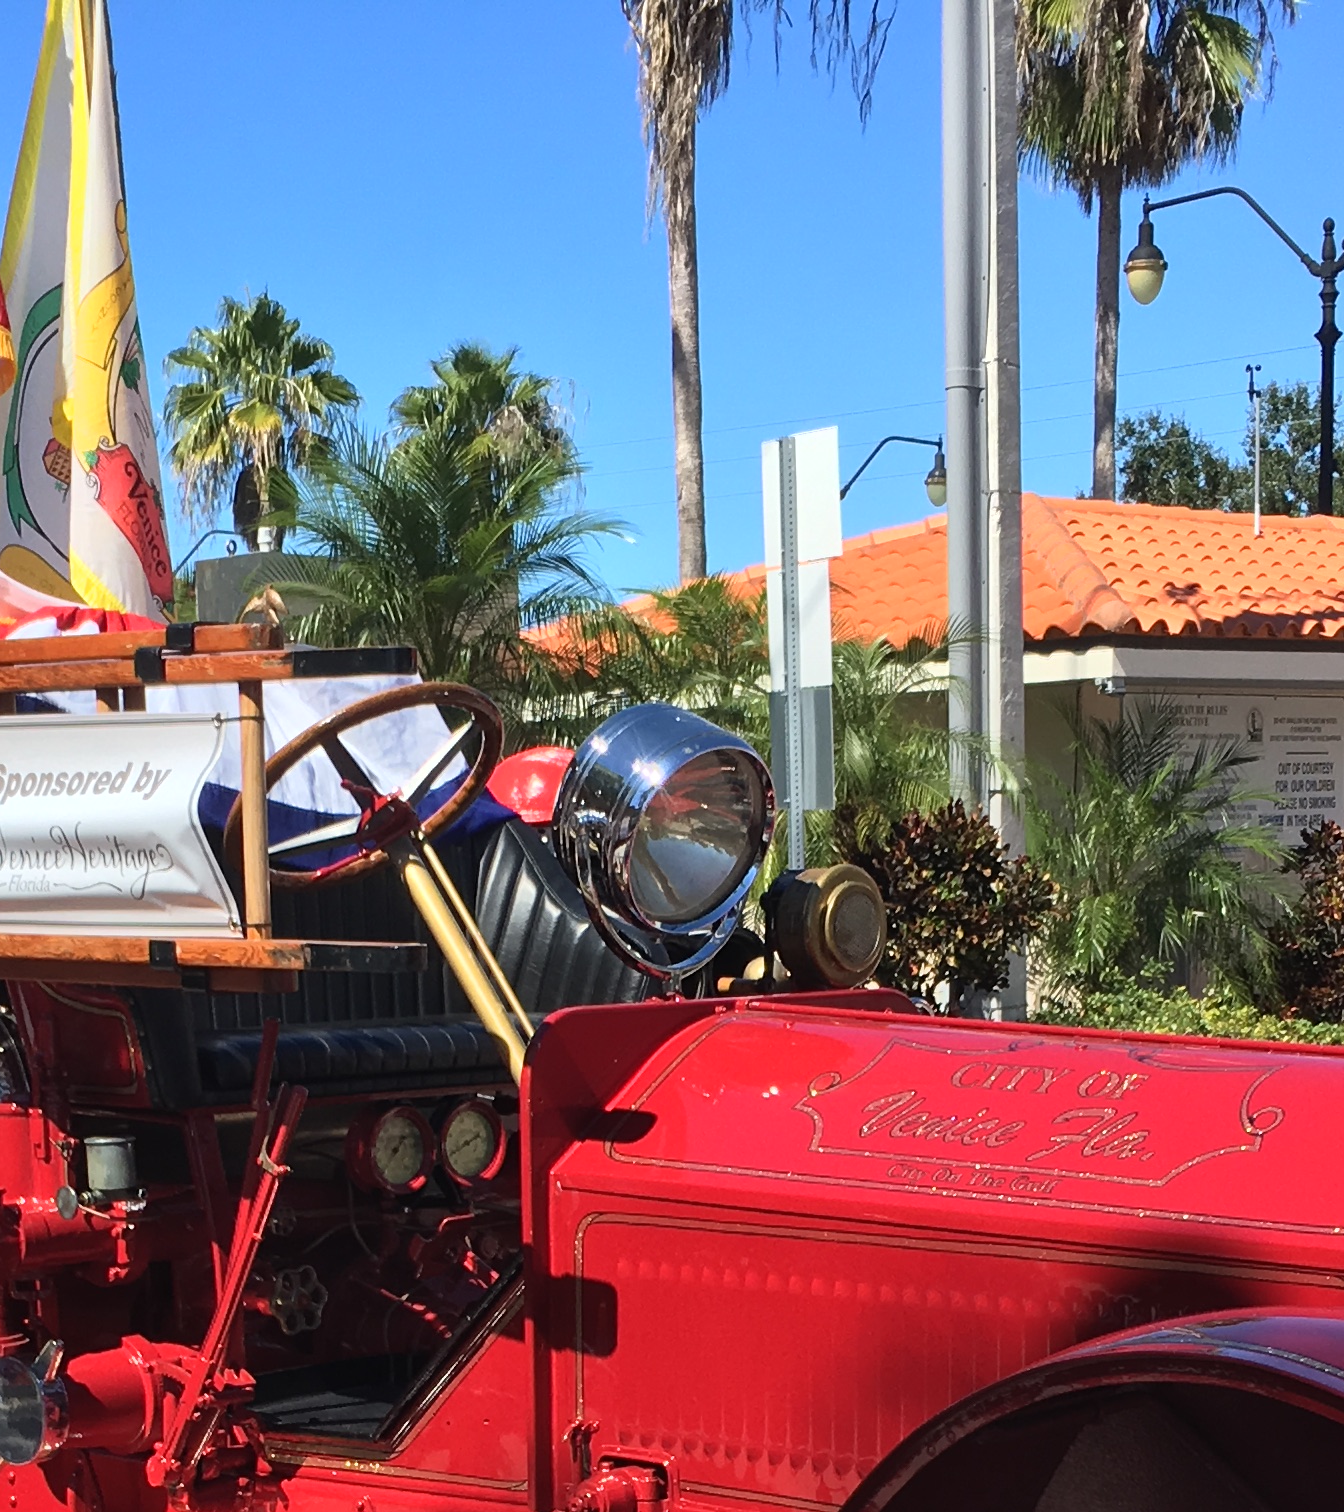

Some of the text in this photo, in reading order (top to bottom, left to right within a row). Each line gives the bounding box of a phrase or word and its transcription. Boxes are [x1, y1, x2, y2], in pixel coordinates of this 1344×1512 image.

[124, 461, 167, 578] Venice
[131, 760, 173, 801] by
[1278, 762, 1335, 775] OUT OF COURTESY
[1274, 779, 1336, 793] FOR OUR CHILDREN
[1273, 796, 1336, 810] PLEASE NO SMOKING
[1294, 814, 1309, 827] THIS
[8, 873, 52, 893] Florida
[949, 1061, 1151, 1101] CITY OF
[858, 1089, 1155, 1163] Venice Fla.
[885, 1162, 1064, 1195] City On The Gulf
